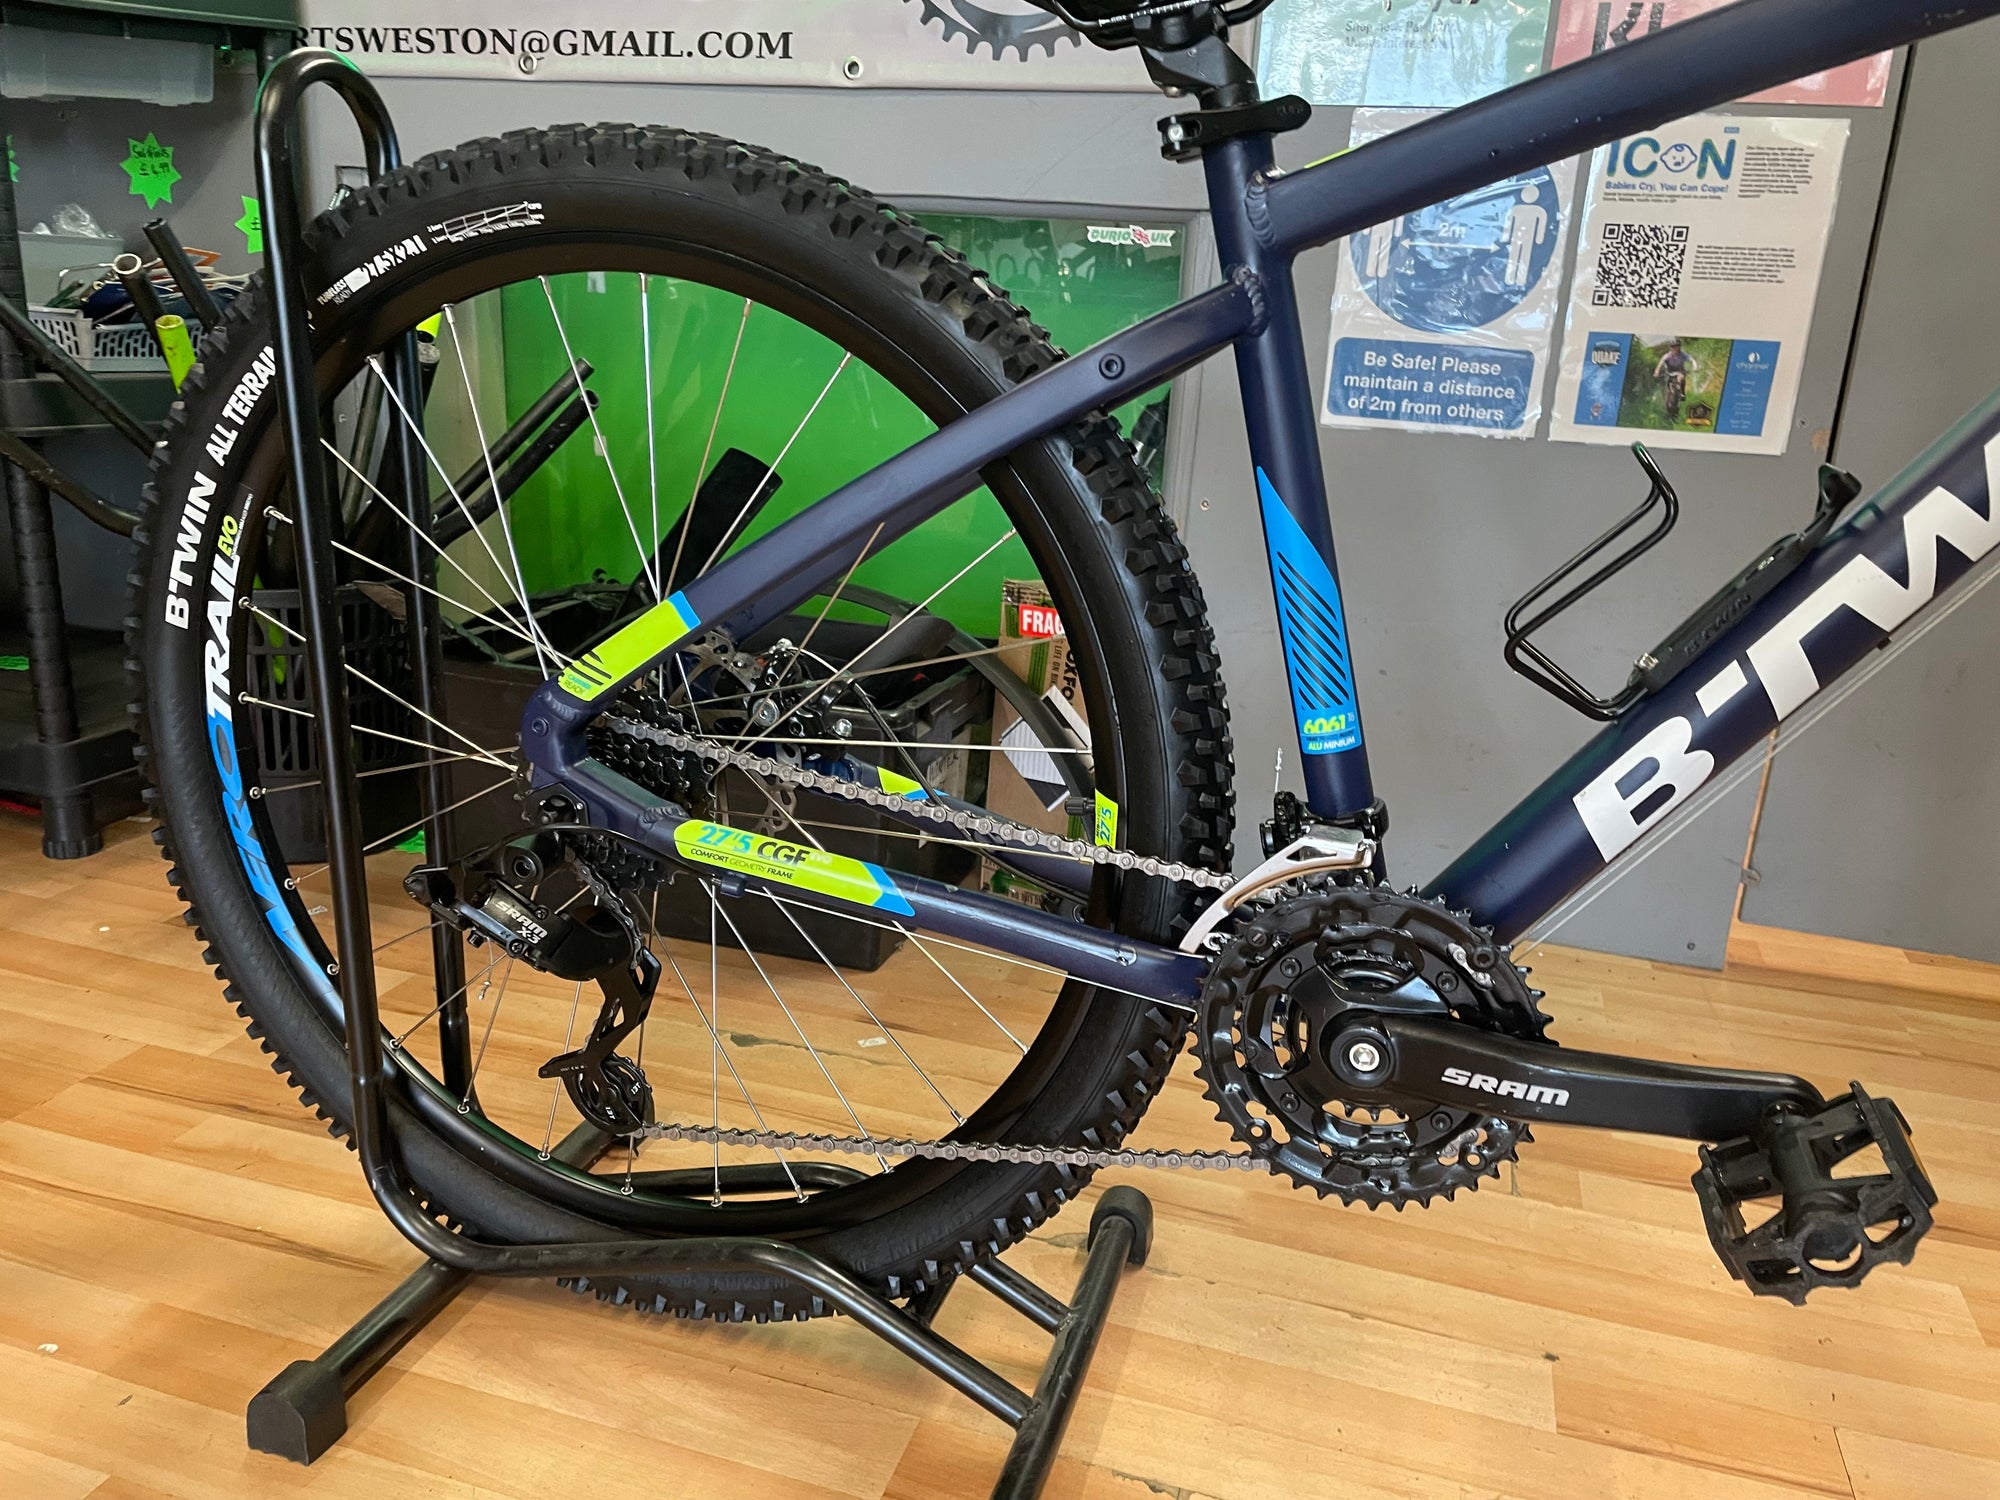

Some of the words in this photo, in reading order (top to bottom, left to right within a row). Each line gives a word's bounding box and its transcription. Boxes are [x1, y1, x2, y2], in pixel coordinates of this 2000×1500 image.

[1605, 181, 1636, 190] Babies
[1660, 183, 1677, 191] You
[1680, 184, 1698, 192] Can
[1701, 184, 1729, 194] Cope!
[1150, 232, 1170, 243] UK
[1438, 222, 1466, 238] 2m
[1363, 351, 1387, 367] Be
[1391, 353, 1436, 371] Safe!
[1441, 357, 1502, 376] Please
[1343, 373, 1418, 392] maintain
[1423, 382, 1433, 393] a
[1439, 380, 1515, 399] distance
[1348, 396, 1366, 409] of
[1370, 396, 1396, 412] 2m
[1401, 398, 1441, 416] from
[1447, 404, 1504, 421] others
[205, 423, 239, 467] ALL
[217, 514, 238, 557] EVO
[1303, 714, 1346, 734] 6061
[690, 848, 729, 863] COMFORT
[729, 858, 767, 873] GEOMETRY
[766, 867, 795, 880] FRAME
[757, 841, 811, 867] CGF
[494, 900, 548, 939] SRAM
[1441, 1067, 1570, 1107] SRAM
